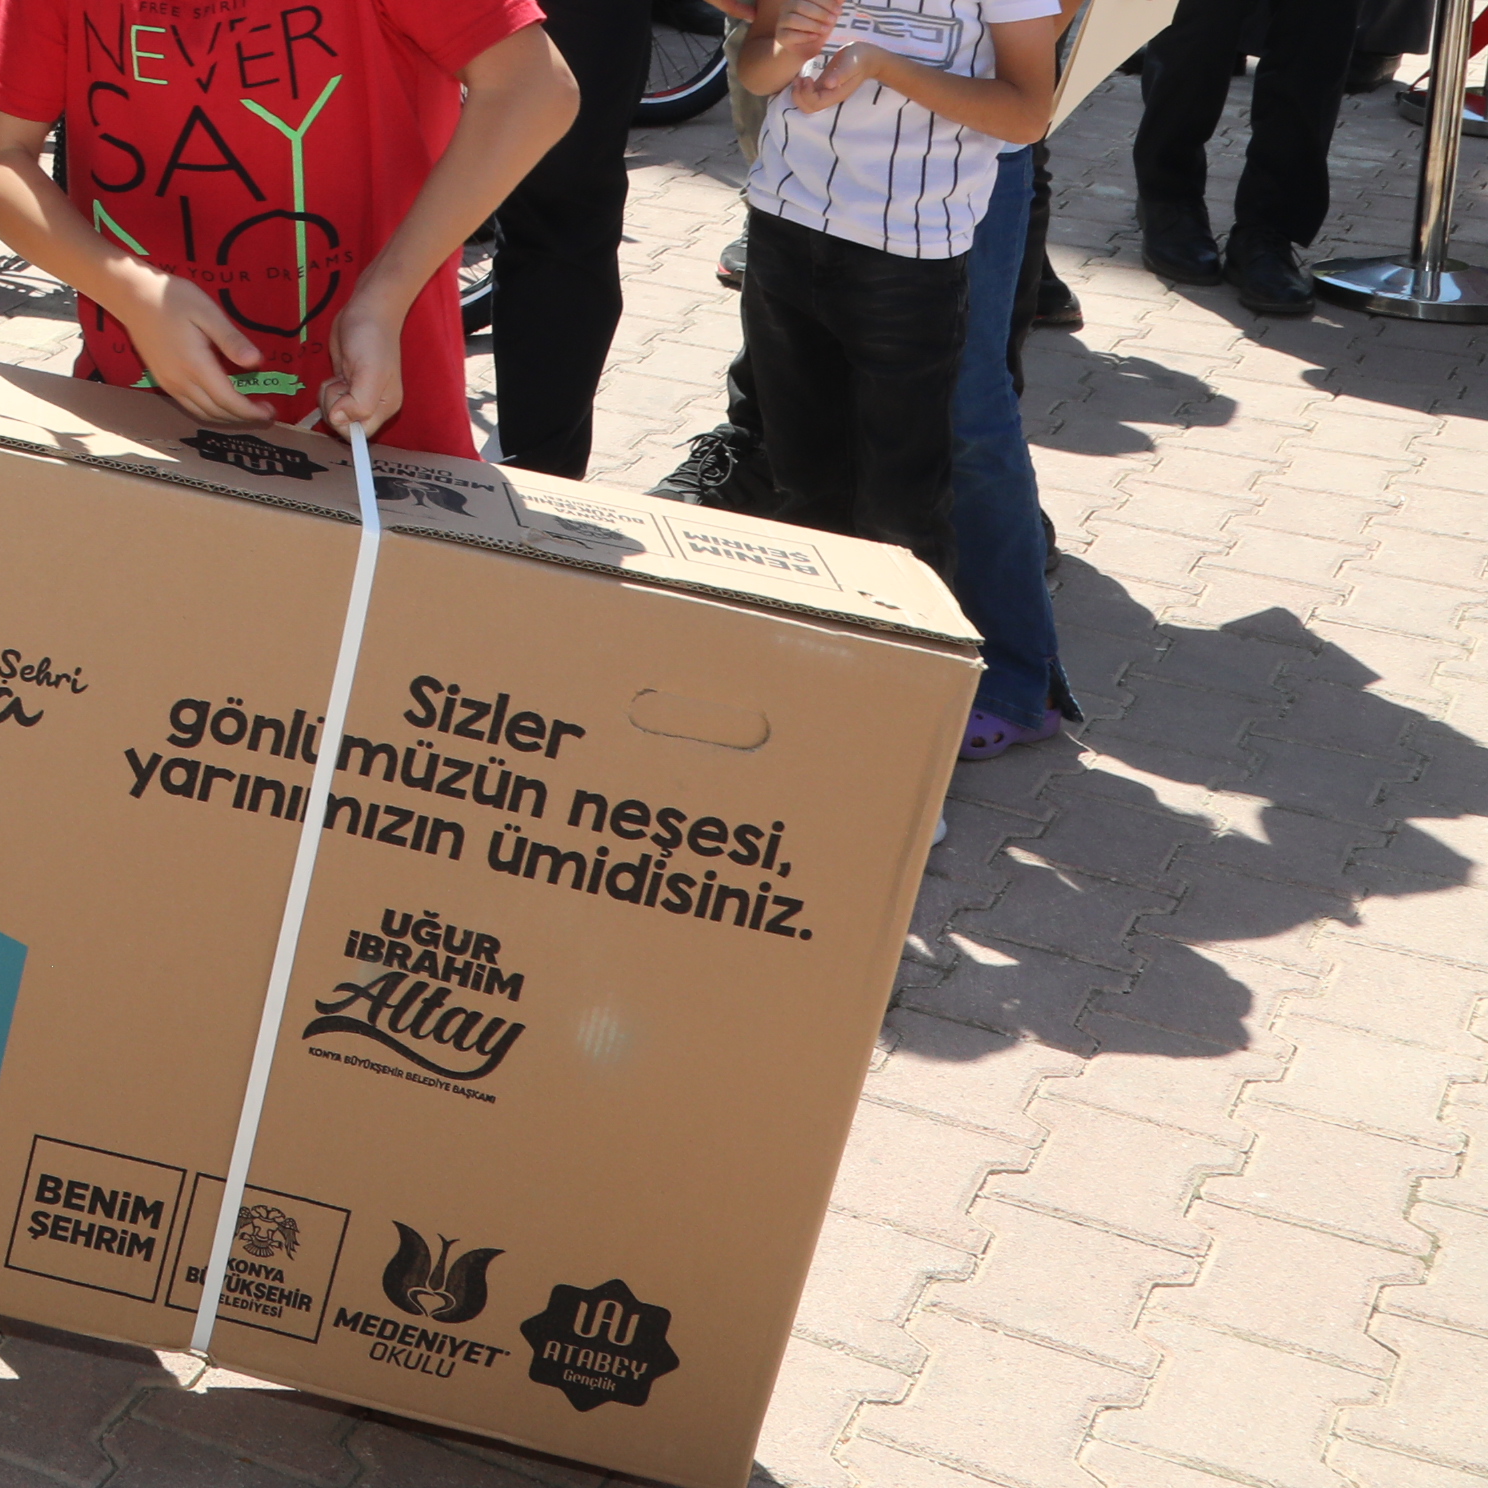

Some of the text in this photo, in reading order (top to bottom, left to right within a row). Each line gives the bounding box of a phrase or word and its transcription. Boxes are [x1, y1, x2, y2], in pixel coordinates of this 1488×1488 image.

[139, 0, 181, 18] FREE
[83, 3, 339, 101] NEVER
[87, 74, 343, 344] SAY
[187, 266, 251, 284] YOUR
[266, 250, 354, 281] DREAMS
[231, 378, 260, 388] EAR
[403, 674, 586, 761] Sizler
[569, 788, 795, 879] neşesi,
[488, 824, 815, 941] ümidisiniz.
[380, 908, 502, 966] UĞUR
[308, 970, 527, 1082] Altay
[308, 1046, 342, 1063] KONYA
[343, 1054, 404, 1079] BÜYÜKŞEHİR
[405, 1070, 451, 1093] BELEDİYE
[226, 1257, 285, 1284] KONYA
[218, 1293, 283, 1319] ELEDİYESİ
[369, 1341, 456, 1379] OKULU
[542, 1340, 648, 1382] ATABEY
[562, 1368, 617, 1393] Gençlik
